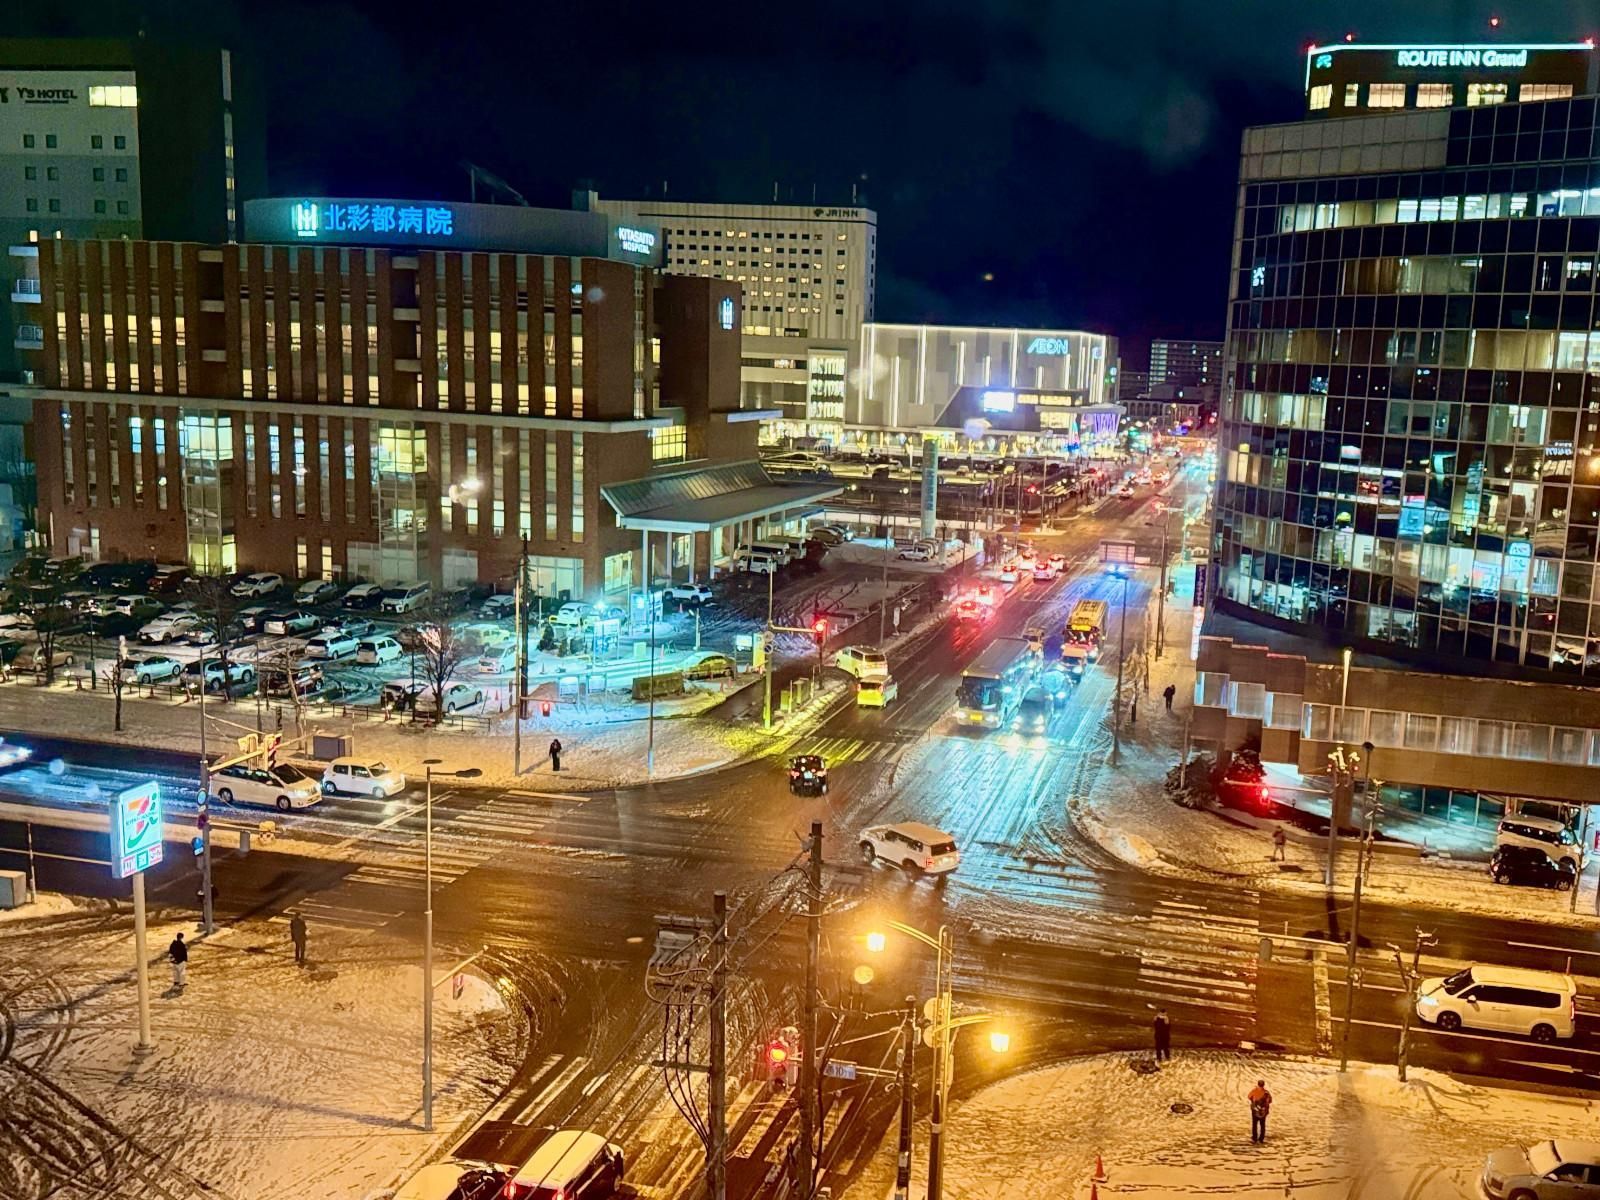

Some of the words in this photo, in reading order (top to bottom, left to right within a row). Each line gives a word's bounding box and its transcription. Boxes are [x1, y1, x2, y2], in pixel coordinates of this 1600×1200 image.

[1397, 50, 1448, 67] ROUTE
[1449, 50, 1481, 66] INN
[1482, 49, 1527, 67] Grand
[37, 88, 78, 99] HOTEL
[324, 203, 453, 236] 北彩都病院
